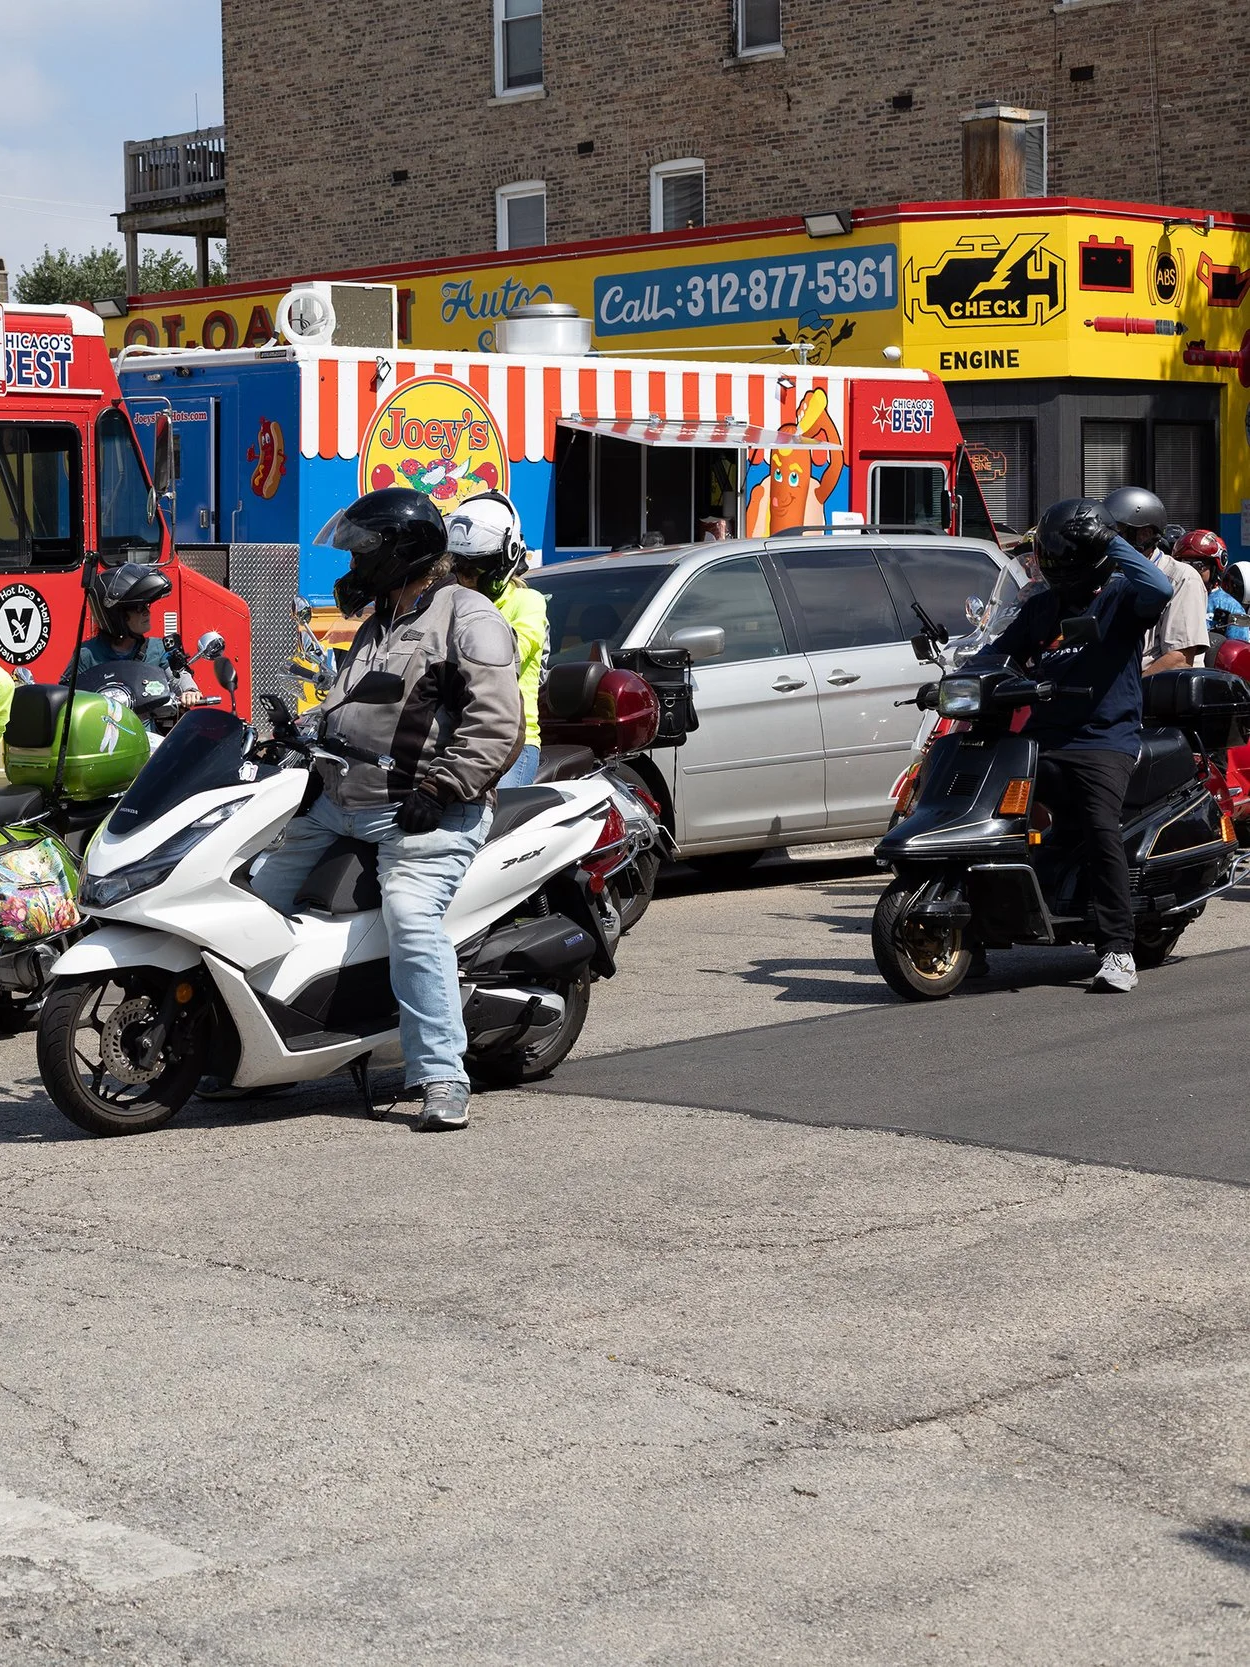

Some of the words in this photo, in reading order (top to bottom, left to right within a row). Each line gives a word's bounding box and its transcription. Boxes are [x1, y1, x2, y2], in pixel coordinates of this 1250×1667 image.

[1156, 269, 1176, 286] ABS
[950, 300, 1021, 317] CHECK
[5, 334, 72, 352] HICAGO'S
[939, 349, 1020, 370] ENGINE
[892, 399, 934, 410] CHICAGO'S
[134, 411, 208, 426] JoeysHots.com
[892, 409, 934, 432] BEST
[380, 408, 490, 460] Joey's
[969, 454, 989, 462] HECK
[0, 586, 16, 601] Hot
[18, 584, 36, 600] Dog
[39, 602, 50, 624] Hall
[42, 626, 49, 639] of
[25, 638, 47, 660] Fame
